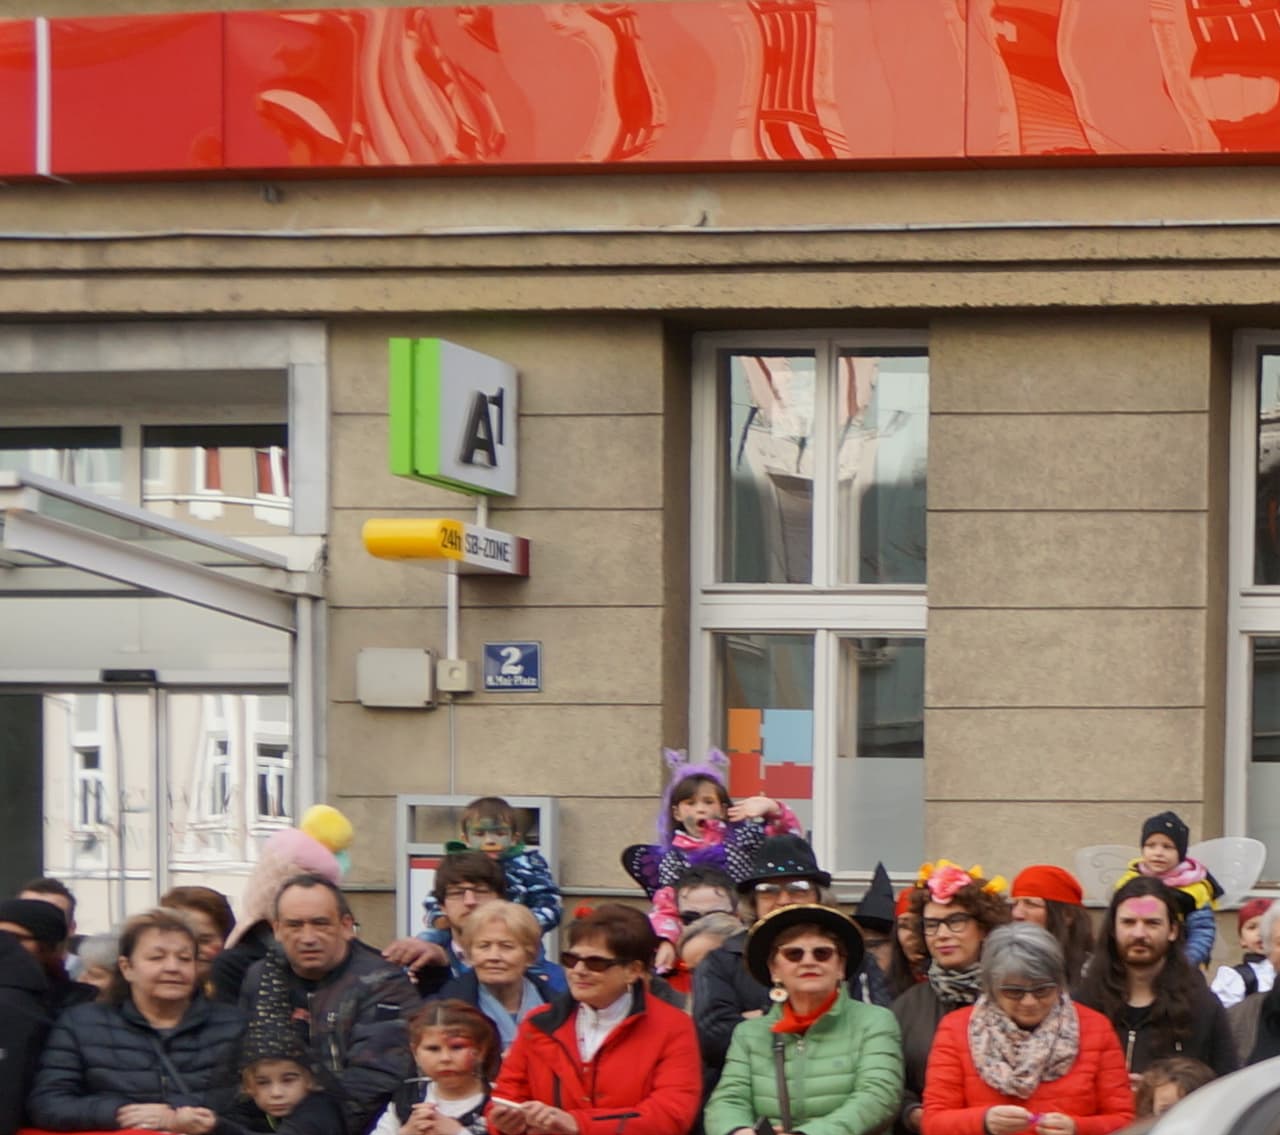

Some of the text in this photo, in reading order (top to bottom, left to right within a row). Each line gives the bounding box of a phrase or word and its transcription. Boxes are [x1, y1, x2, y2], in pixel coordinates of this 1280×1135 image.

[459, 387, 504, 467] A1
[441, 527, 511, 562] 24h SB-ZONE
[500, 646, 525, 675] 2
